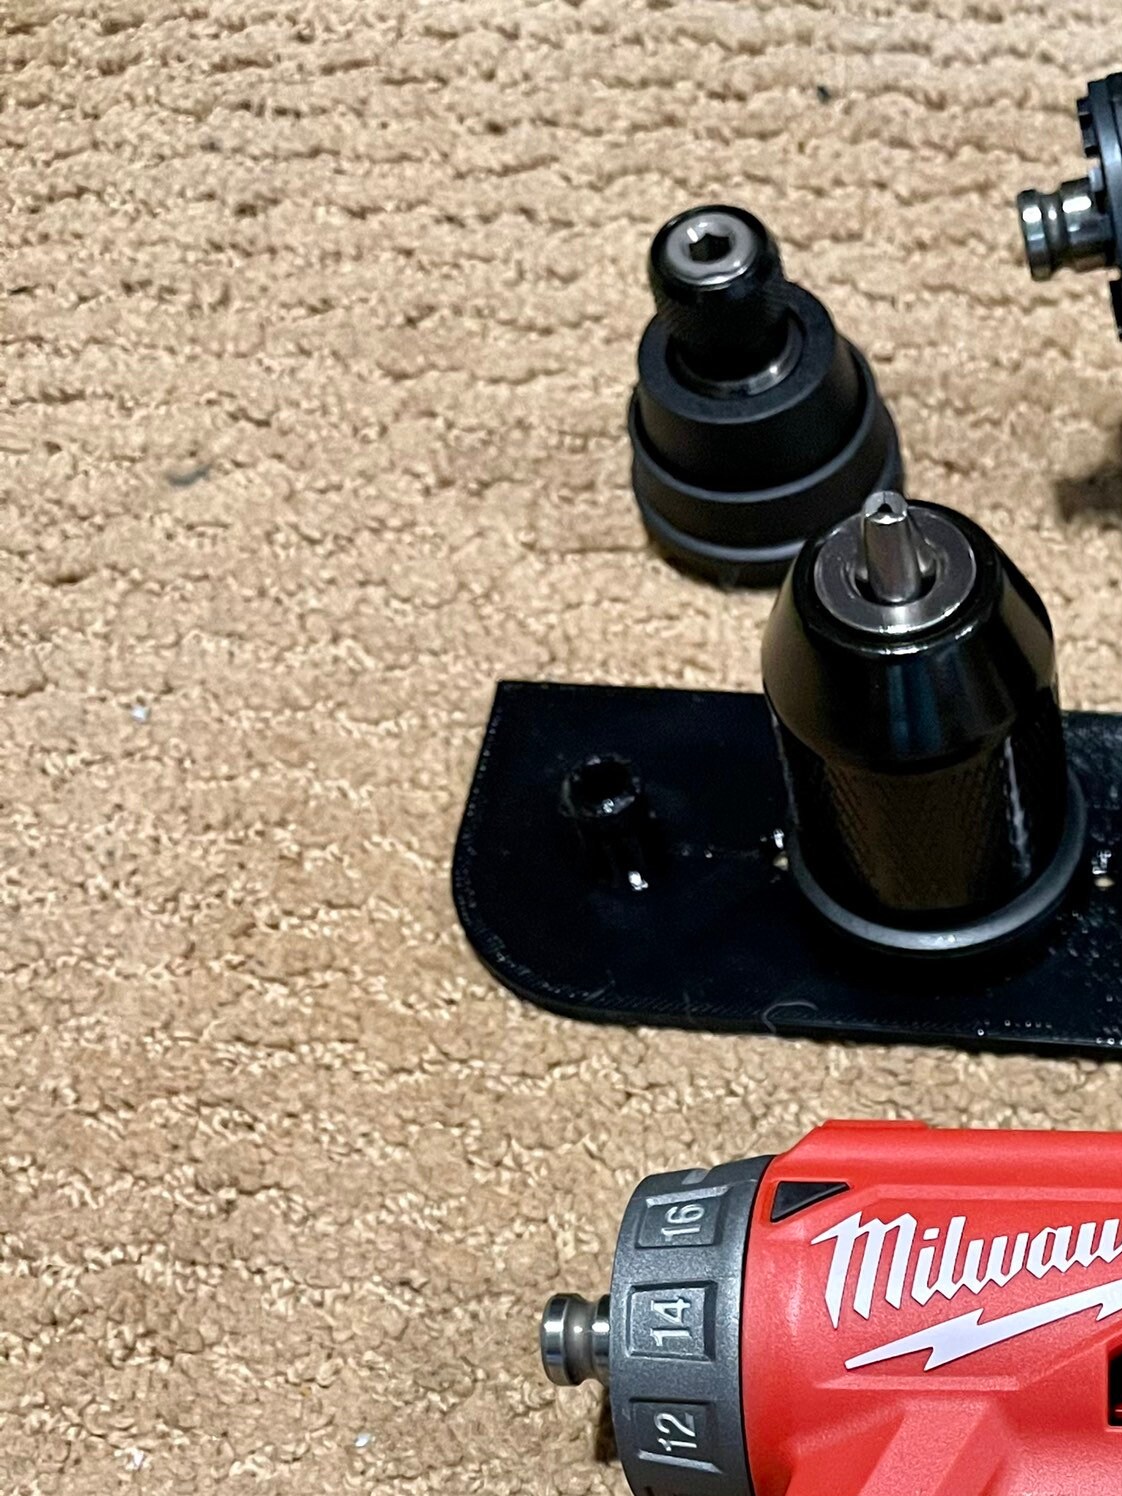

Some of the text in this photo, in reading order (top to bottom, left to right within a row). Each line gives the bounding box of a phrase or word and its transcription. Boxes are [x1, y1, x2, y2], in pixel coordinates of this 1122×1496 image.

[660, 1203, 706, 1242] 16
[650, 1296, 693, 1347] 14
[653, 1412, 698, 1452] 12
